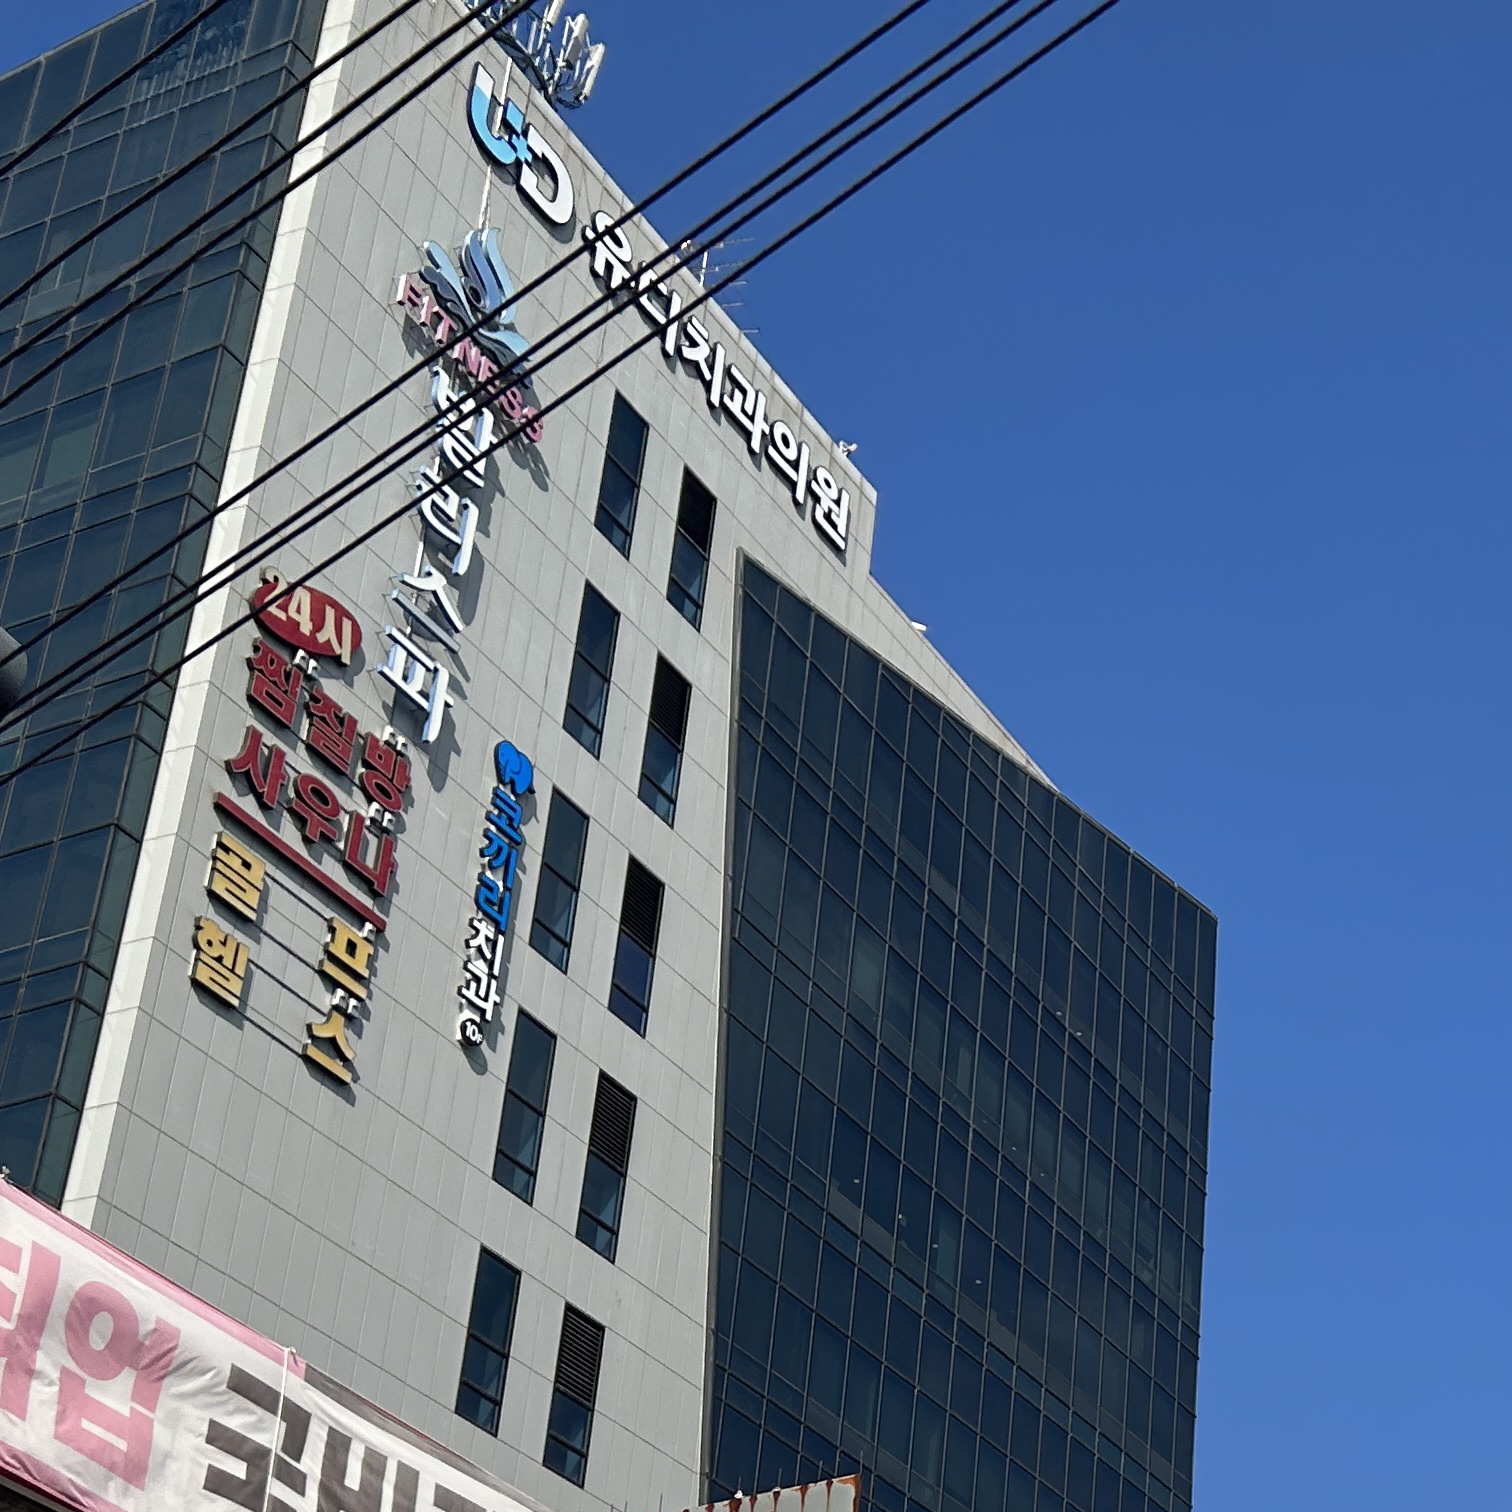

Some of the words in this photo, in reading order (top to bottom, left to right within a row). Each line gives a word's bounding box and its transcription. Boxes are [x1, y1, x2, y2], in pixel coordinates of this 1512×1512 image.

[396, 274, 545, 443] FITNESS
[583, 210, 850, 552] 유디치과의원
[260, 566, 355, 667] 24시
[247, 636, 411, 812] 찜질방
[226, 725, 398, 897] 사우나
[464, 1020, 484, 1044] 10F
